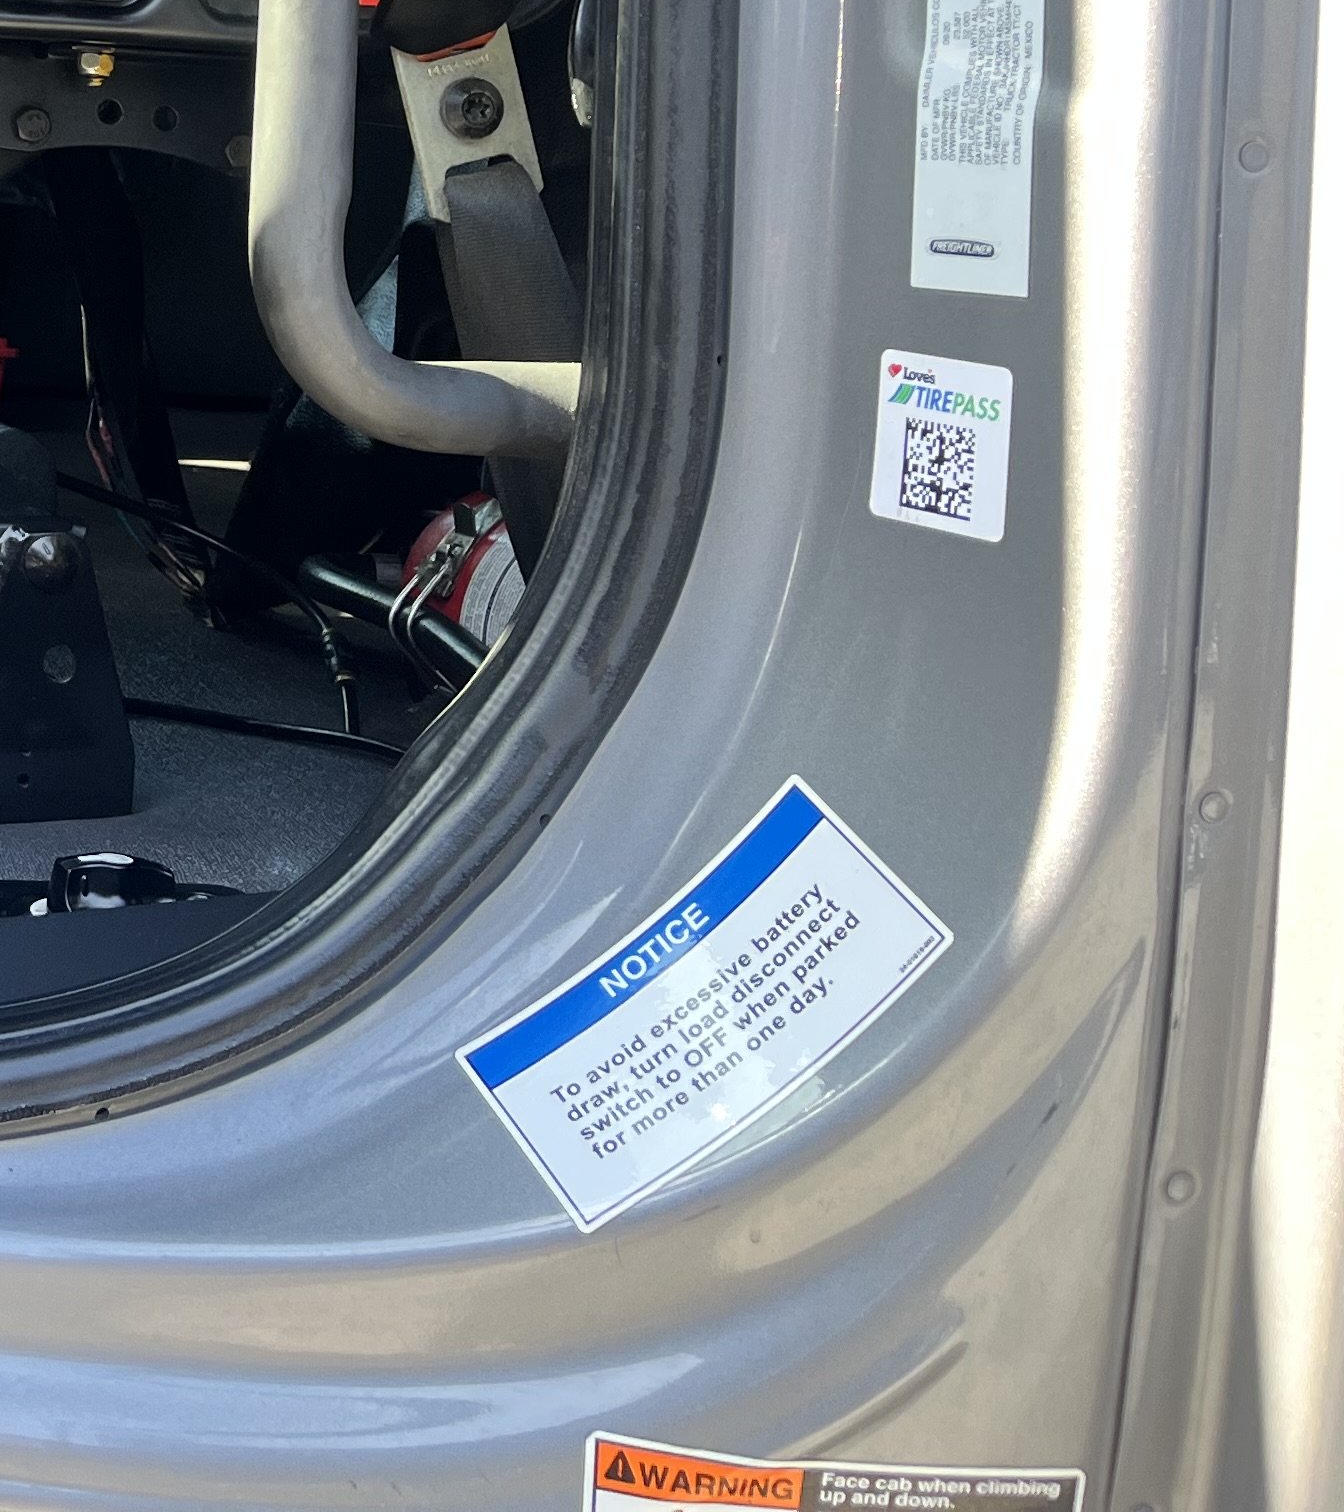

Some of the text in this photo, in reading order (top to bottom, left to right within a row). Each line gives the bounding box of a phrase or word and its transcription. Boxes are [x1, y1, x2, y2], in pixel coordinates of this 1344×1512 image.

[931, 240, 993, 257] FREIGHTLINER
[916, 386, 1001, 421] TIREPASS
[599, 902, 710, 998] NOTICE
[550, 883, 823, 1104] To avoid excessive battery
[567, 898, 841, 1122] draw, turn load disconnect
[580, 910, 861, 1140] switch to OFF when parked
[592, 977, 834, 1160] for more than one day.
[639, 1462, 794, 1500] WARNING
[819, 1489, 956, 1509] up and down.
[821, 1472, 1061, 1500] Face cab when climbing
